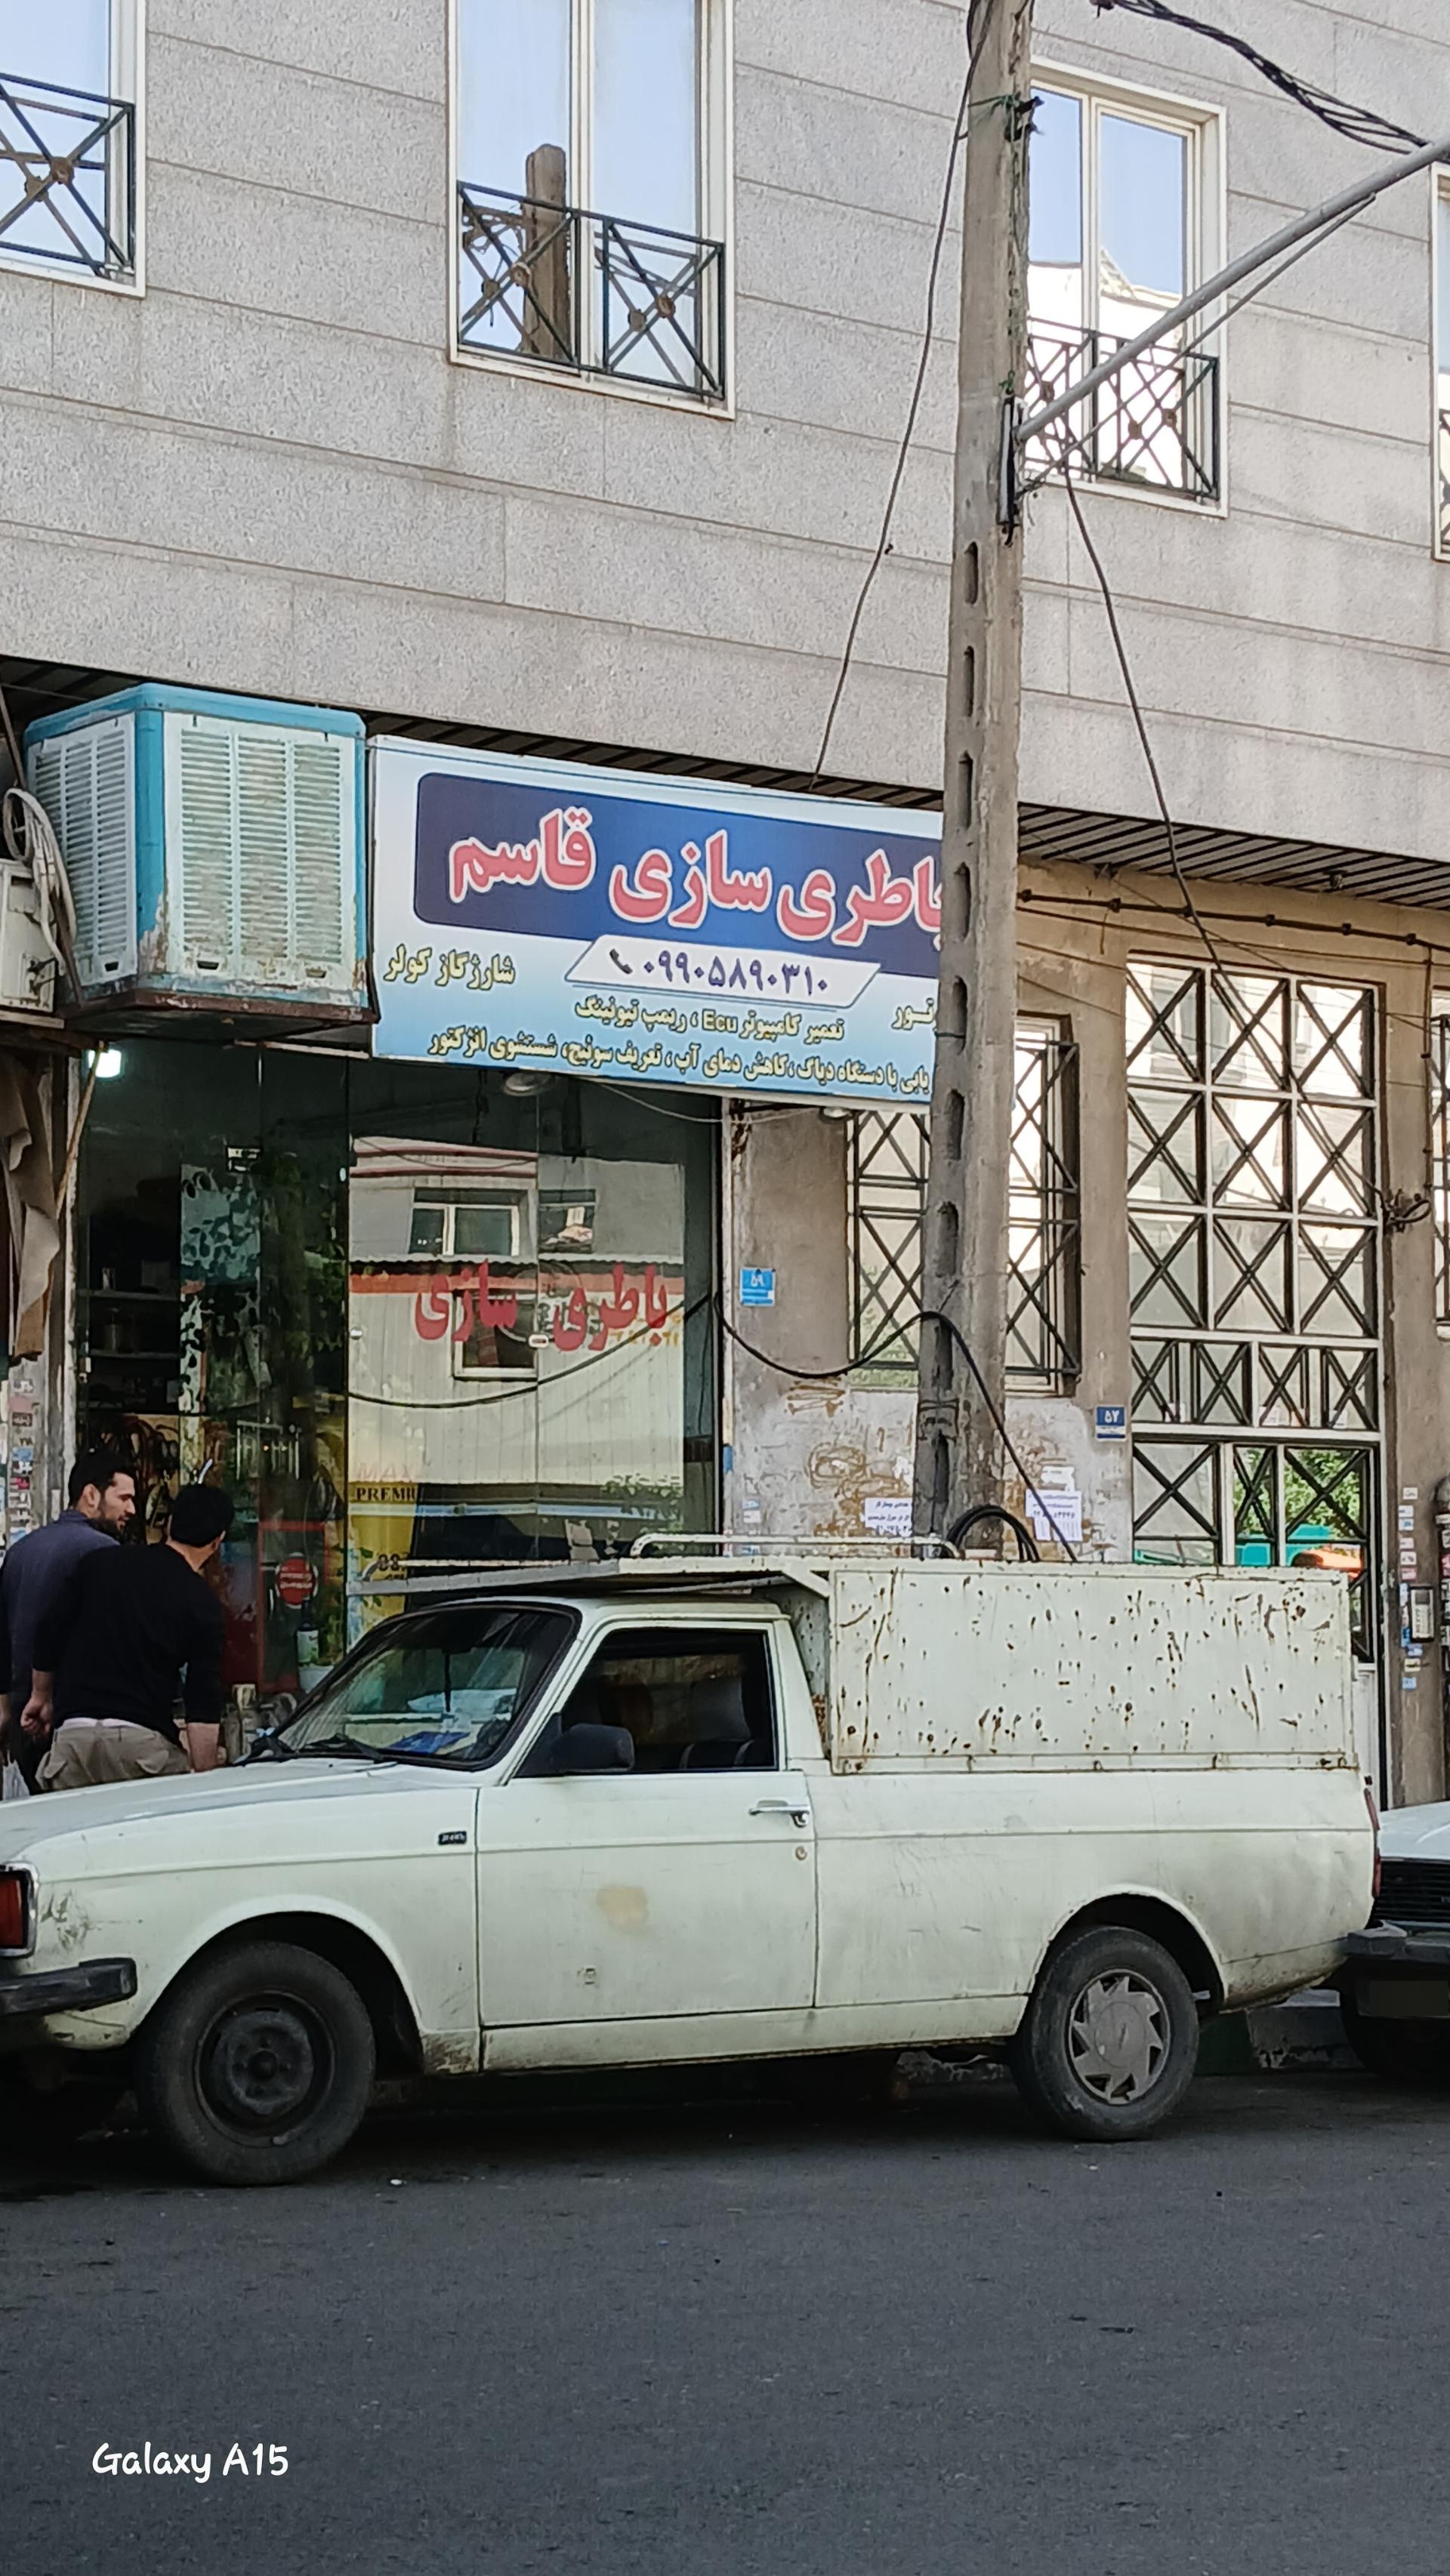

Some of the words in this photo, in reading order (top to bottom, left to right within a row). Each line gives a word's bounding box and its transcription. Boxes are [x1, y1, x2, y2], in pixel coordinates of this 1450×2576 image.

[449, 807, 596, 904] قاسم
[609, 830, 772, 928] سازی
[383, 944, 432, 984] کولر
[643, 950, 828, 996] ۰۹۹۰۵۸۹۰۳۱۰
[702, 1009, 738, 1033] Ecu
[739, 1010, 802, 1042] کامپیوتر
[804, 1018, 845, 1045] تعمیر
[615, 1040, 663, 1072] تعریف
[674, 1043, 701, 1074] آب
[702, 1047, 742, 1077] دمای
[836, 1059, 884, 1086] دستگاه
[881, 1063, 899, 1093] با
[415, 1258, 517, 1341] سازی
[553, 1262, 668, 1351] باطری
